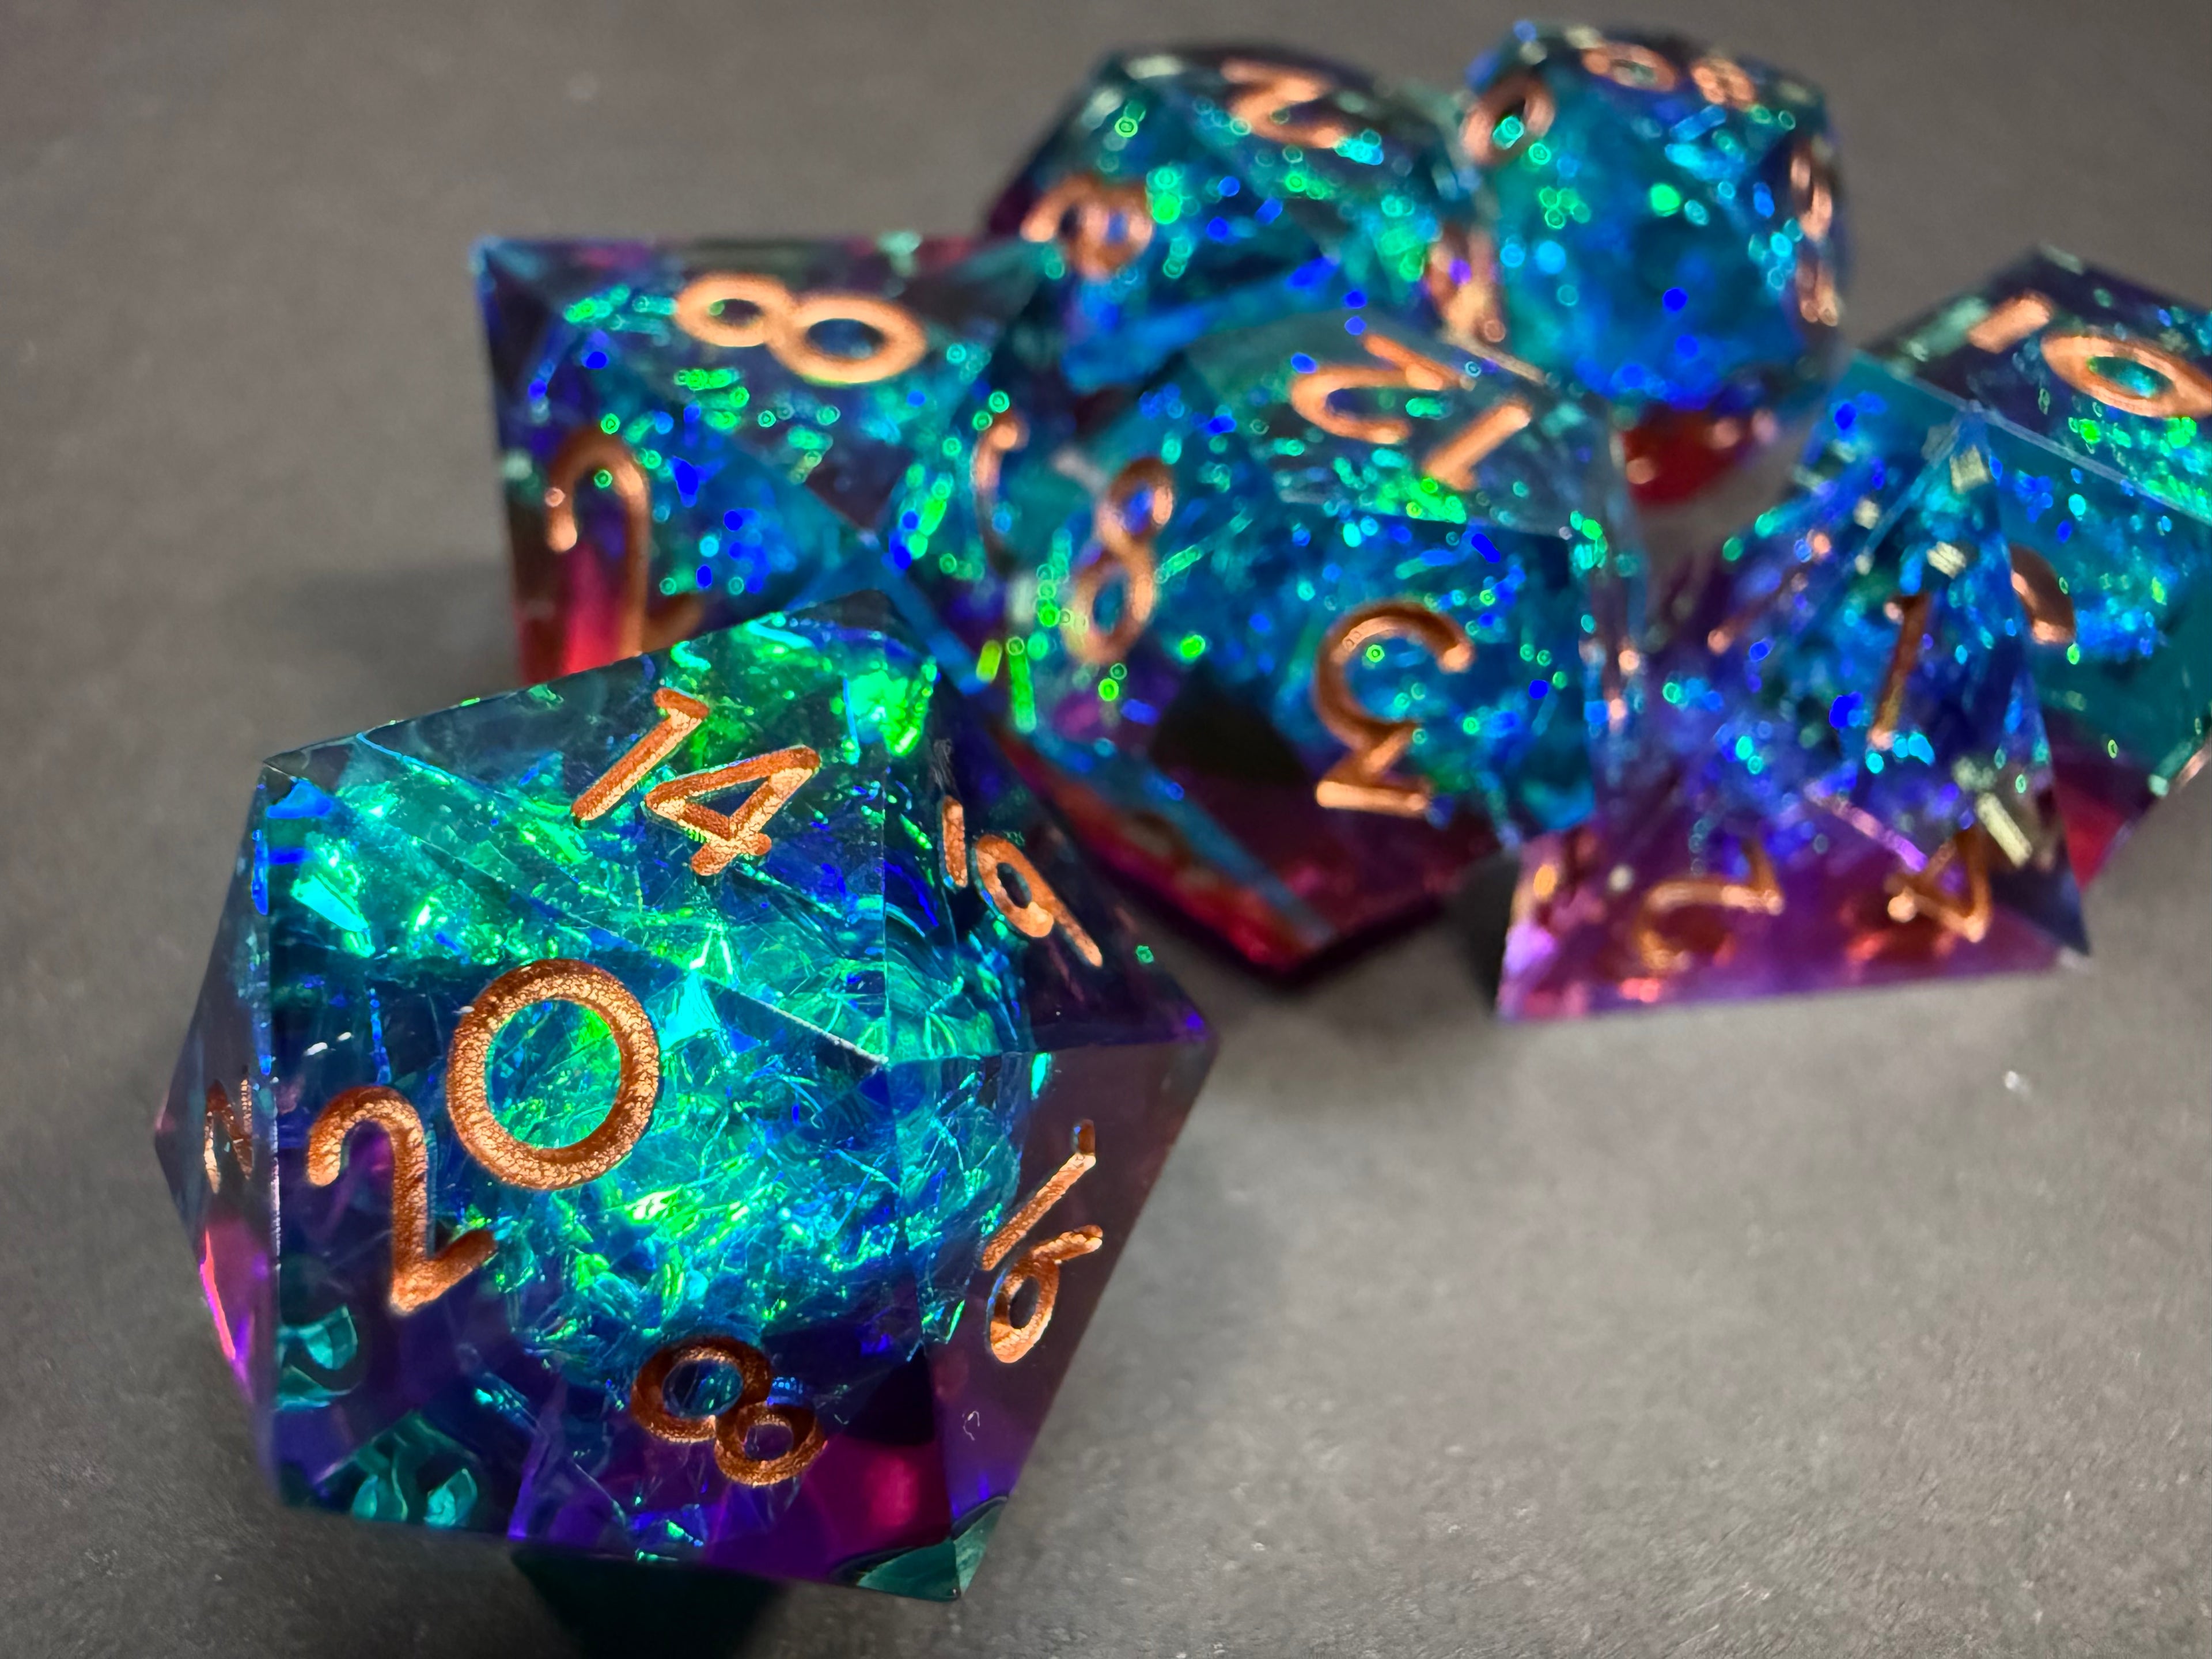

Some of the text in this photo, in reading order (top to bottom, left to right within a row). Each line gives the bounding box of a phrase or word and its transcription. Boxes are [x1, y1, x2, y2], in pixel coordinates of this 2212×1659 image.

[674, 271, 929, 388] 8
[570, 685, 822, 877] 14
[305, 956, 661, 1317] 20
[979, 1119, 1104, 1364] 16
[629, 1334, 830, 1487] 8
